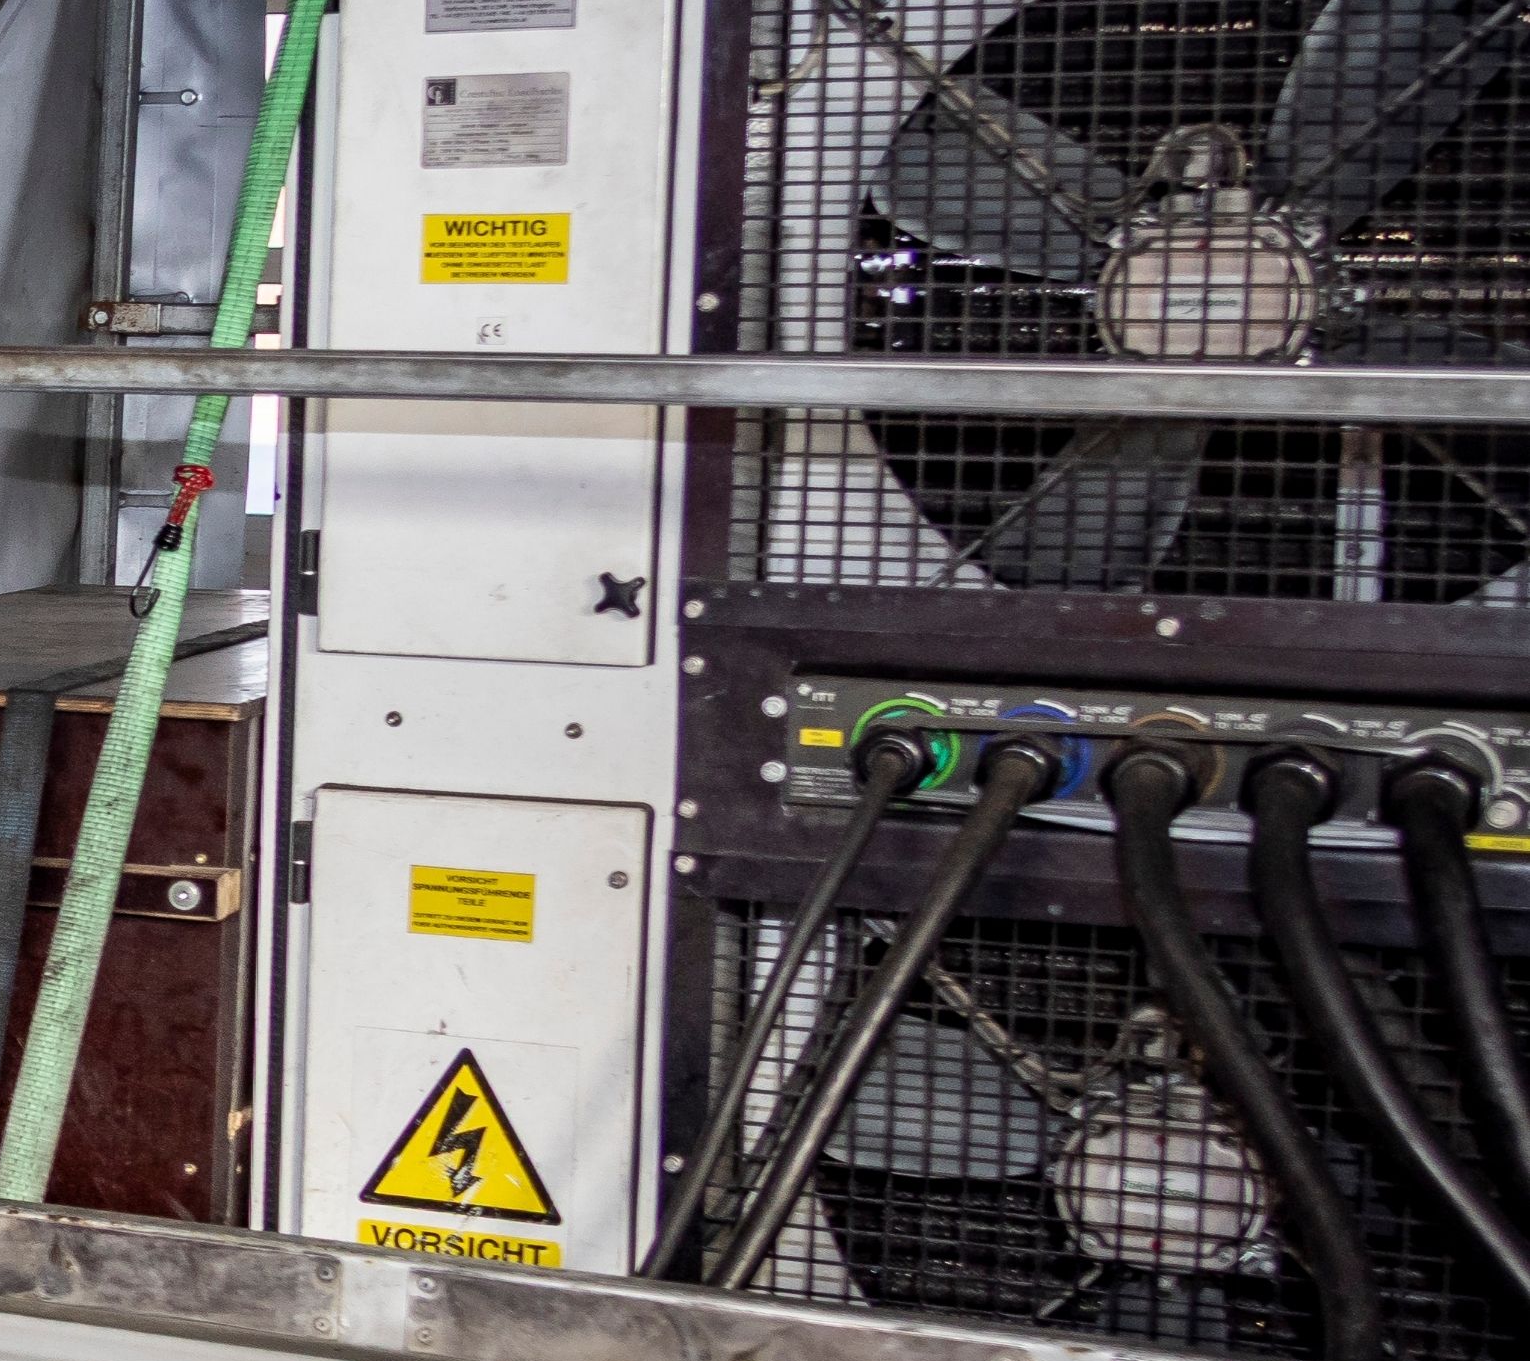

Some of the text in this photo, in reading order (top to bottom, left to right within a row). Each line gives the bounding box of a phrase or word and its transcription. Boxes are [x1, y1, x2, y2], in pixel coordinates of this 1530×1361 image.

[444, 219, 548, 237] WICHTIG
[480, 323, 502, 338] CE
[370, 1224, 548, 1266] VORSICHT
